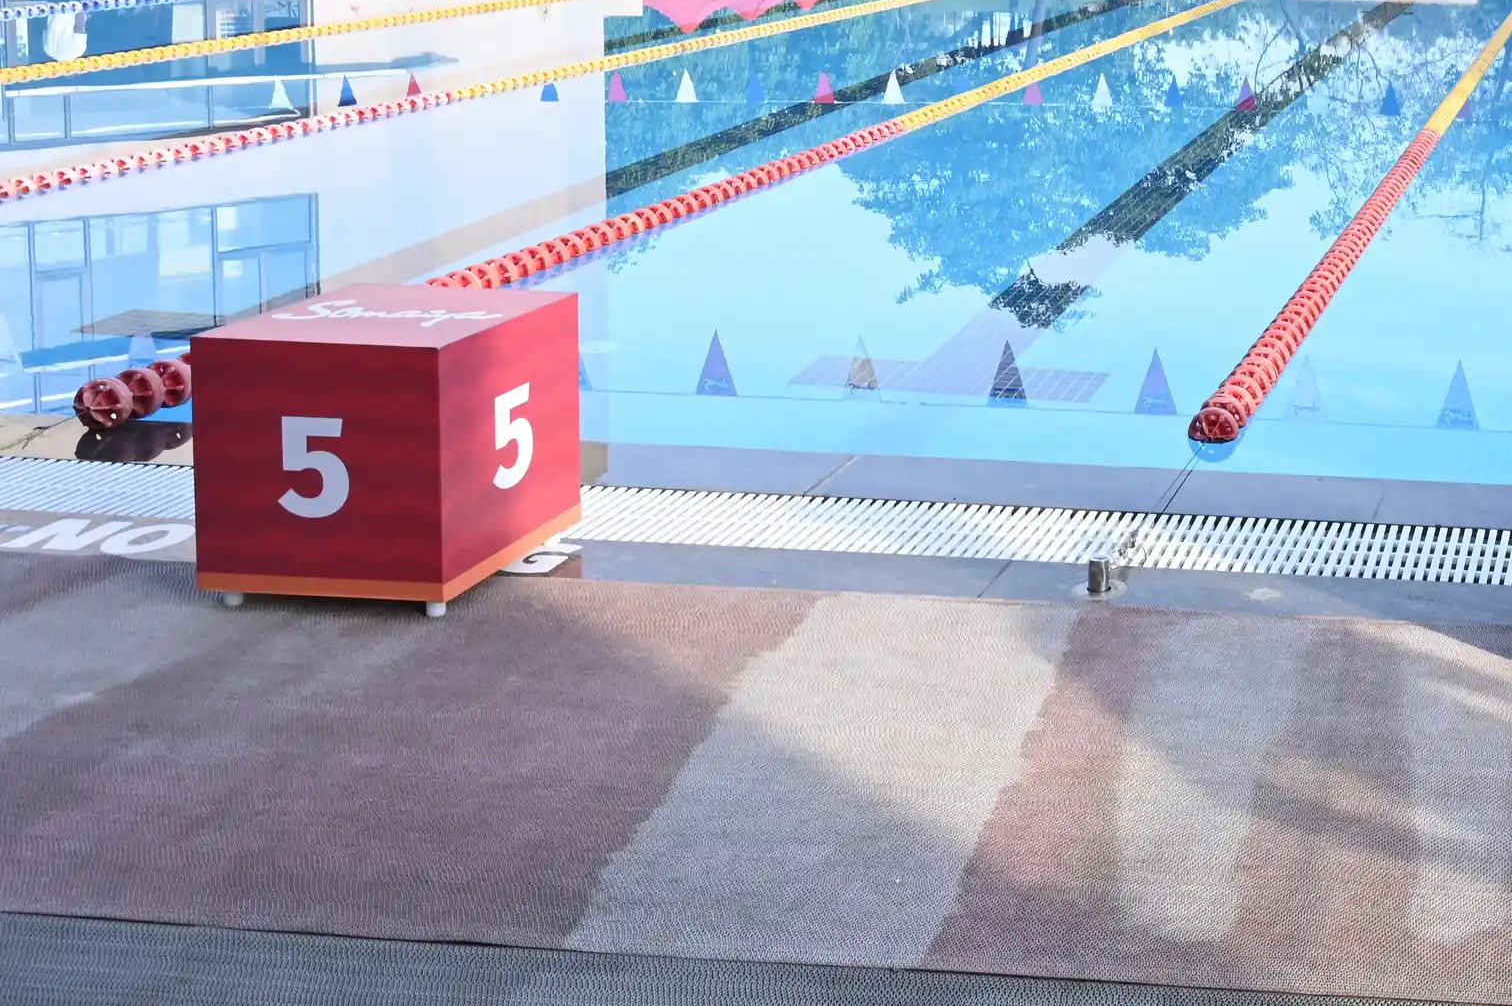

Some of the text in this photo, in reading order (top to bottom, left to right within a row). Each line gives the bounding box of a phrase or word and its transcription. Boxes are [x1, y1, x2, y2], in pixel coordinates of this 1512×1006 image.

[271, 299, 503, 328] Somaiya
[277, 414, 351, 519] 5
[492, 381, 535, 491] 5
[0, 517, 196, 556] NO
